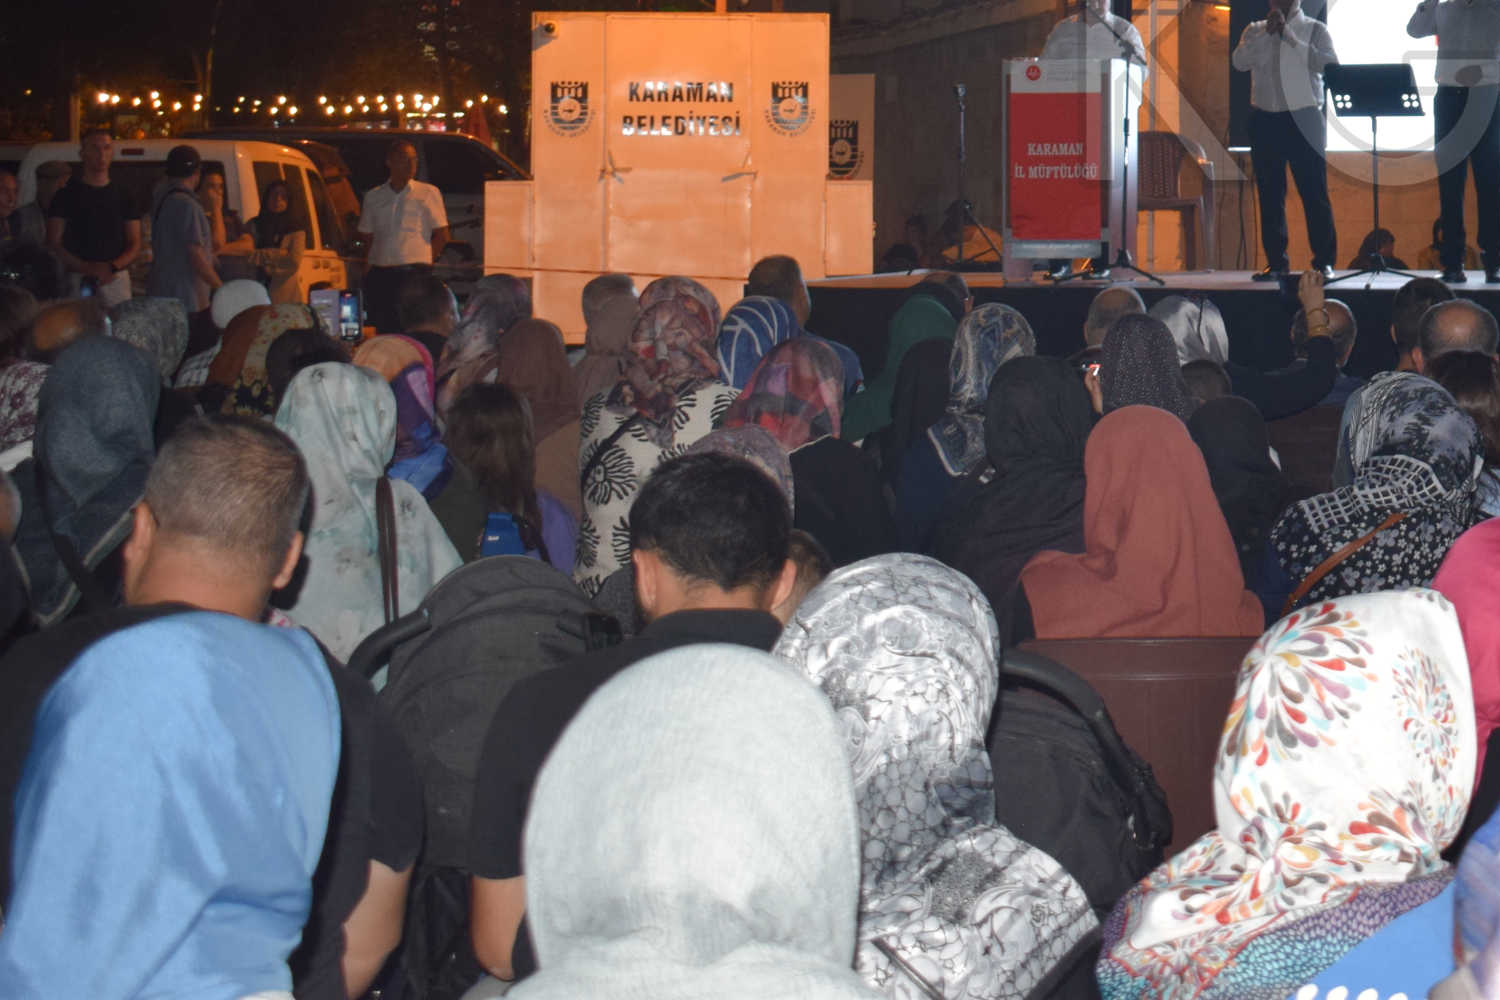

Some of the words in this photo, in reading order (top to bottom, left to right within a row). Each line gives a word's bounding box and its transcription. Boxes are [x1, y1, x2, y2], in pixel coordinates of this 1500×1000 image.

[628, 81, 733, 102] KARAMAN
[622, 110, 741, 136] BELEDİYESİ
[1027, 143, 1083, 155] KARAMAN
[1014, 163, 1025, 178] İL
[1028, 163, 1097, 179] MÜFTÜLÜĞÜ
